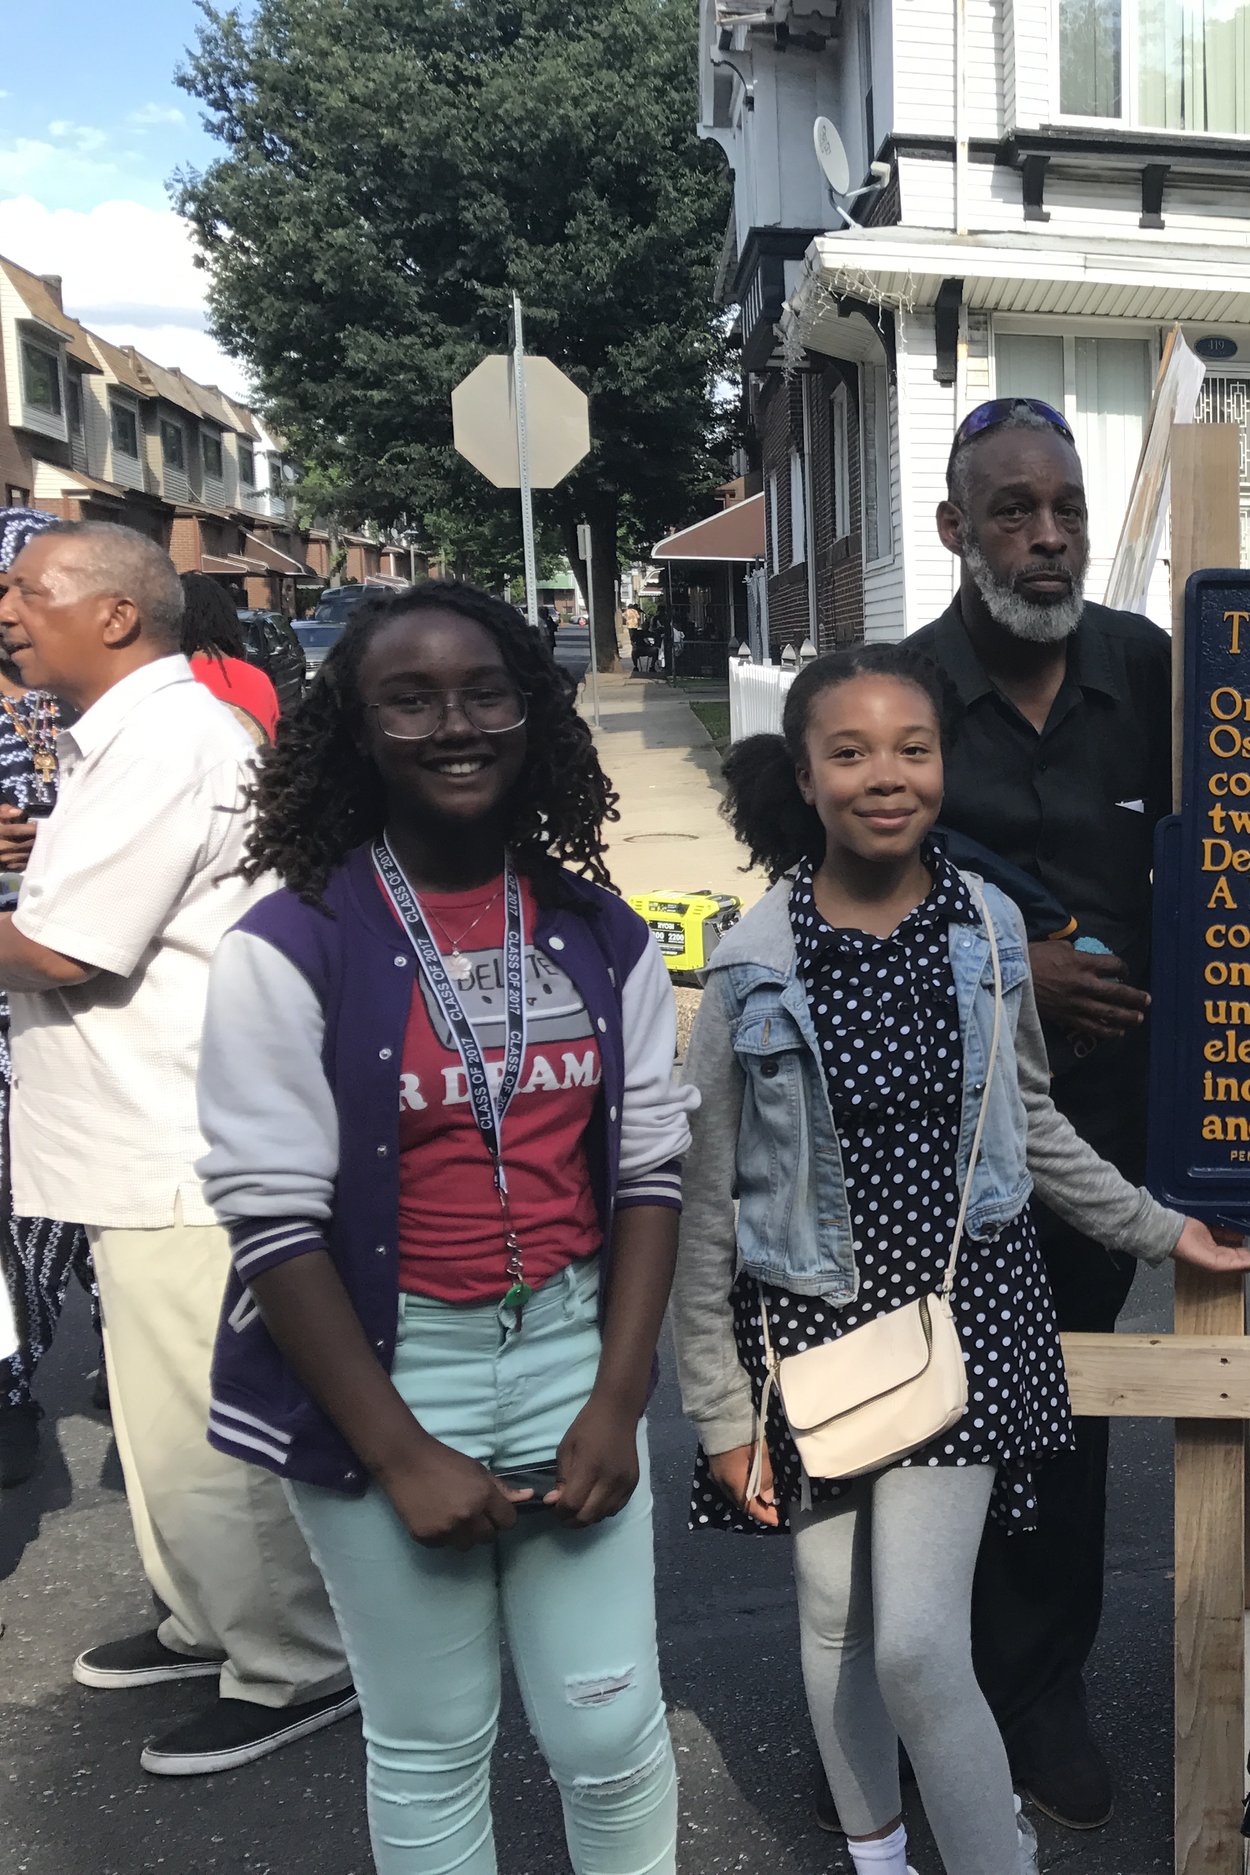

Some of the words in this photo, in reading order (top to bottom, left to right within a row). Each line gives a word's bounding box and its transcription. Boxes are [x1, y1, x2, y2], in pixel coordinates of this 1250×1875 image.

[376, 847, 394, 871] 2017
[386, 871, 401, 887] OF
[507, 875, 516, 891] OF
[393, 884, 420, 924] CLASS
[508, 891, 519, 917] 2017
[1207, 876, 1237, 910] A
[417, 938, 438, 965] 2017
[508, 930, 520, 970] CLASS
[429, 965, 445, 981] OF
[458, 954, 559, 992] DELTE
[508, 971, 521, 989] OF
[437, 981, 463, 1021] CLASS
[508, 989, 521, 1016] 2017
[461, 1037, 480, 1064] 2017
[508, 1030, 522, 1073] CLASS
[441, 1050, 602, 1106] DRAM
[470, 1067, 485, 1085] OF
[502, 1075, 516, 1094] OF
[474, 1086, 493, 1130] CLASS
